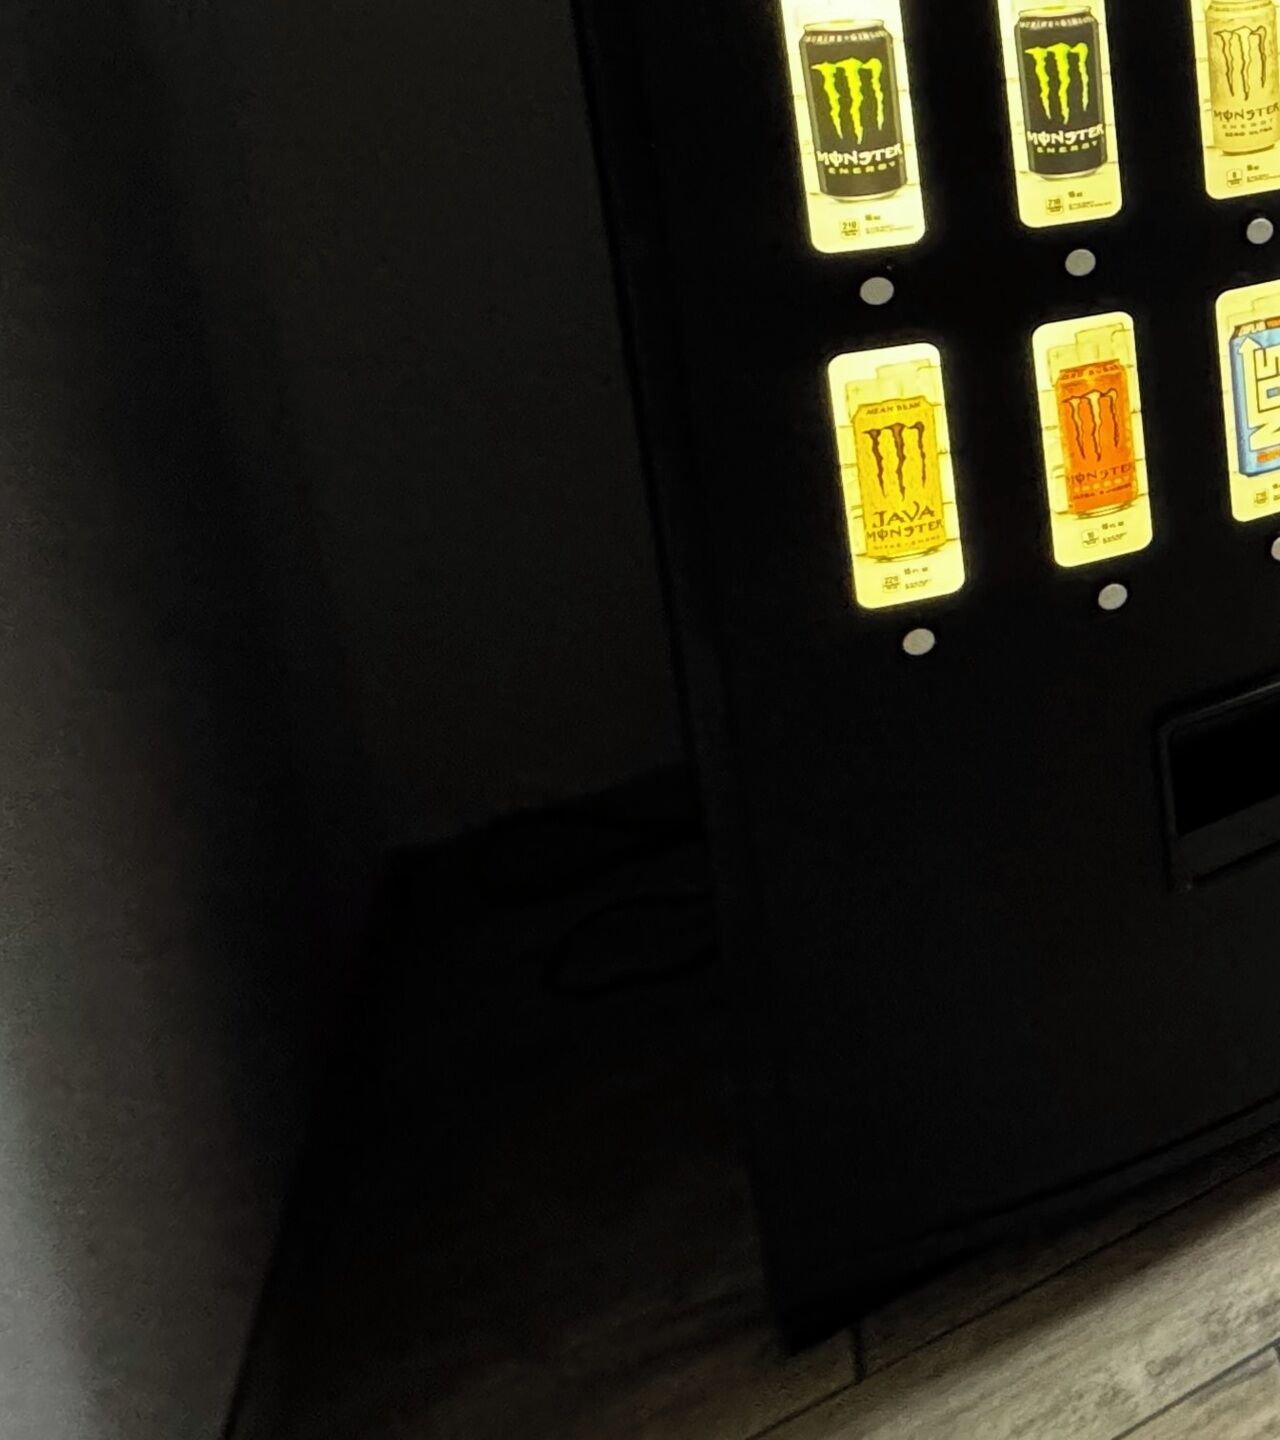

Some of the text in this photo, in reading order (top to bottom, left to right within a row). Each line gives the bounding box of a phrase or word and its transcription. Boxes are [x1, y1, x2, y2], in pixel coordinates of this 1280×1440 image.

[1213, 102, 1280, 122] MONSTER
[1026, 123, 1105, 147] MONSTER
[816, 143, 903, 167] MONSTER
[872, 500, 936, 528] JAVA
[866, 519, 944, 542] MONSTER
